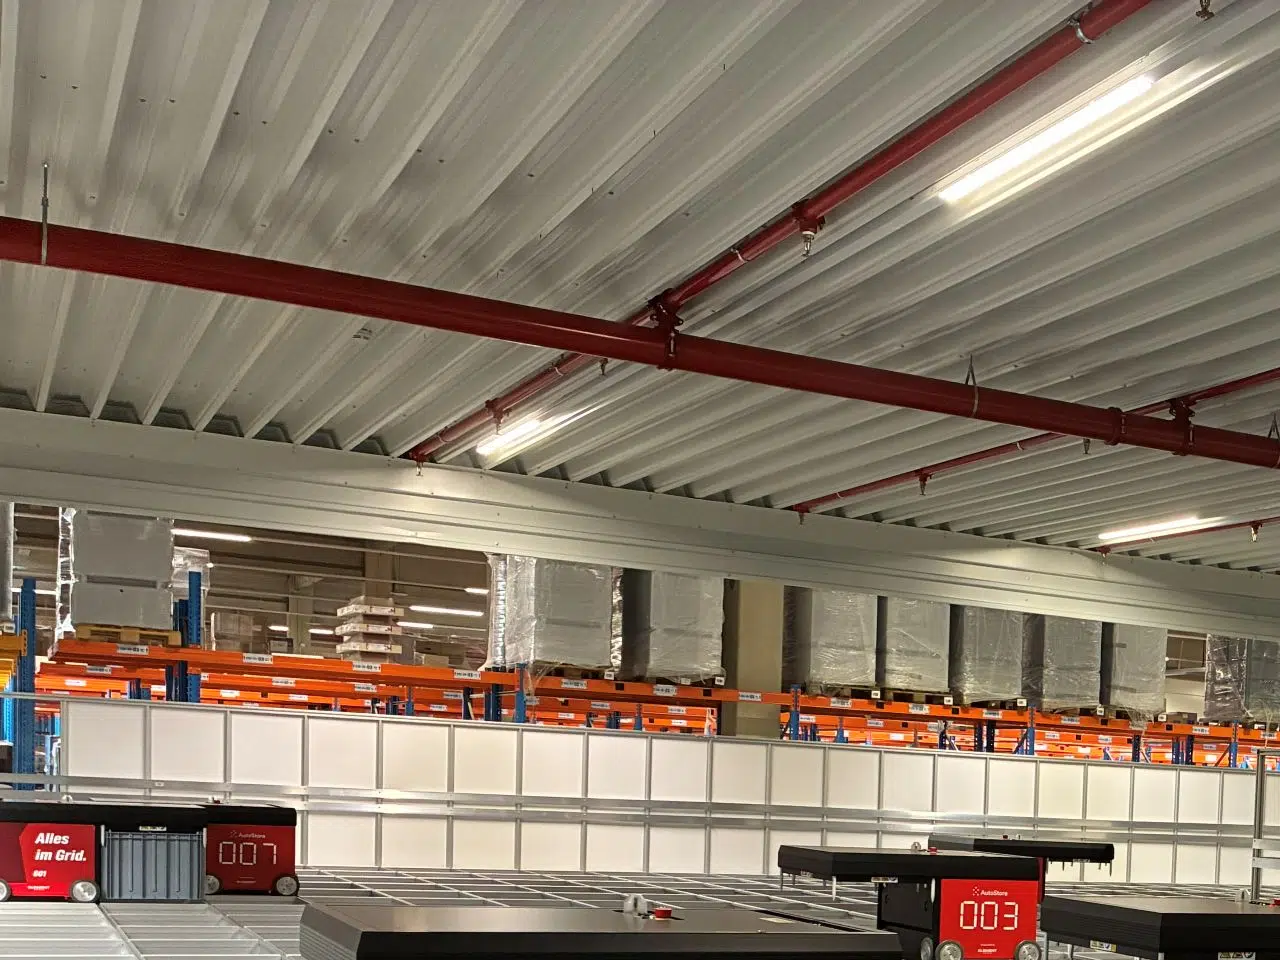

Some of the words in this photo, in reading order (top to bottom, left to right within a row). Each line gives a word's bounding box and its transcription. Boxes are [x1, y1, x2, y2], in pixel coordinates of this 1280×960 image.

[35, 832, 70, 845] Alles
[35, 849, 53, 861] im
[55, 849, 87, 862] Grid.
[219, 841, 277, 865] 007
[960, 901, 1018, 930] 003
